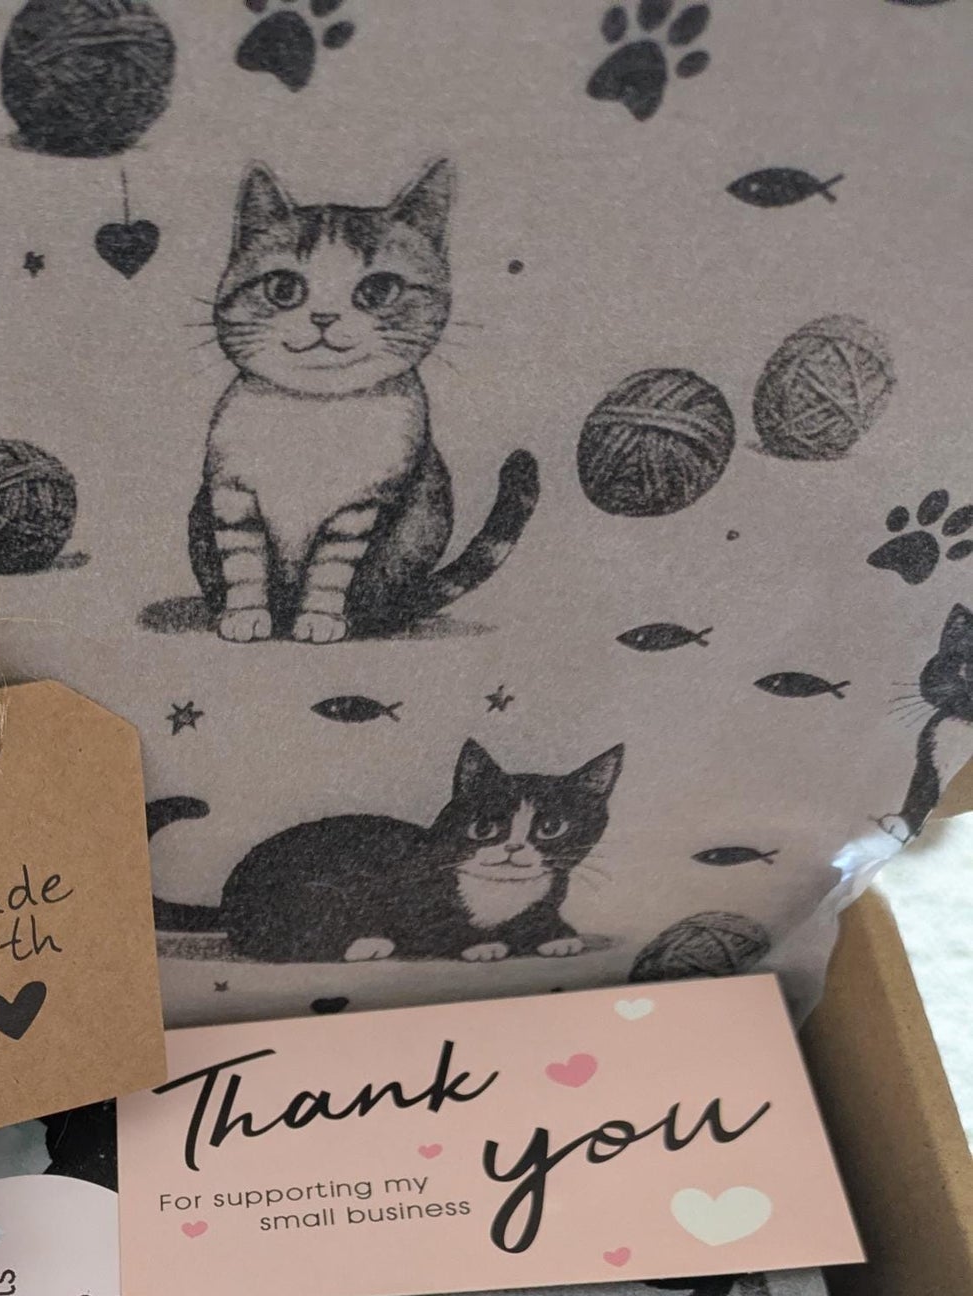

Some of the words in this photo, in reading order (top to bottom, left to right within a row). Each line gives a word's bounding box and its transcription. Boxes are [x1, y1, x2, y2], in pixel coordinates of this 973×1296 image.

[152, 1039, 499, 1172] Thank
[159, 1193, 202, 1212] For
[213, 1180, 372, 1208] supporting
[384, 1176, 428, 1194] my
[260, 1208, 335, 1231] small
[347, 1200, 471, 1225] business
[481, 1097, 772, 1254] you
